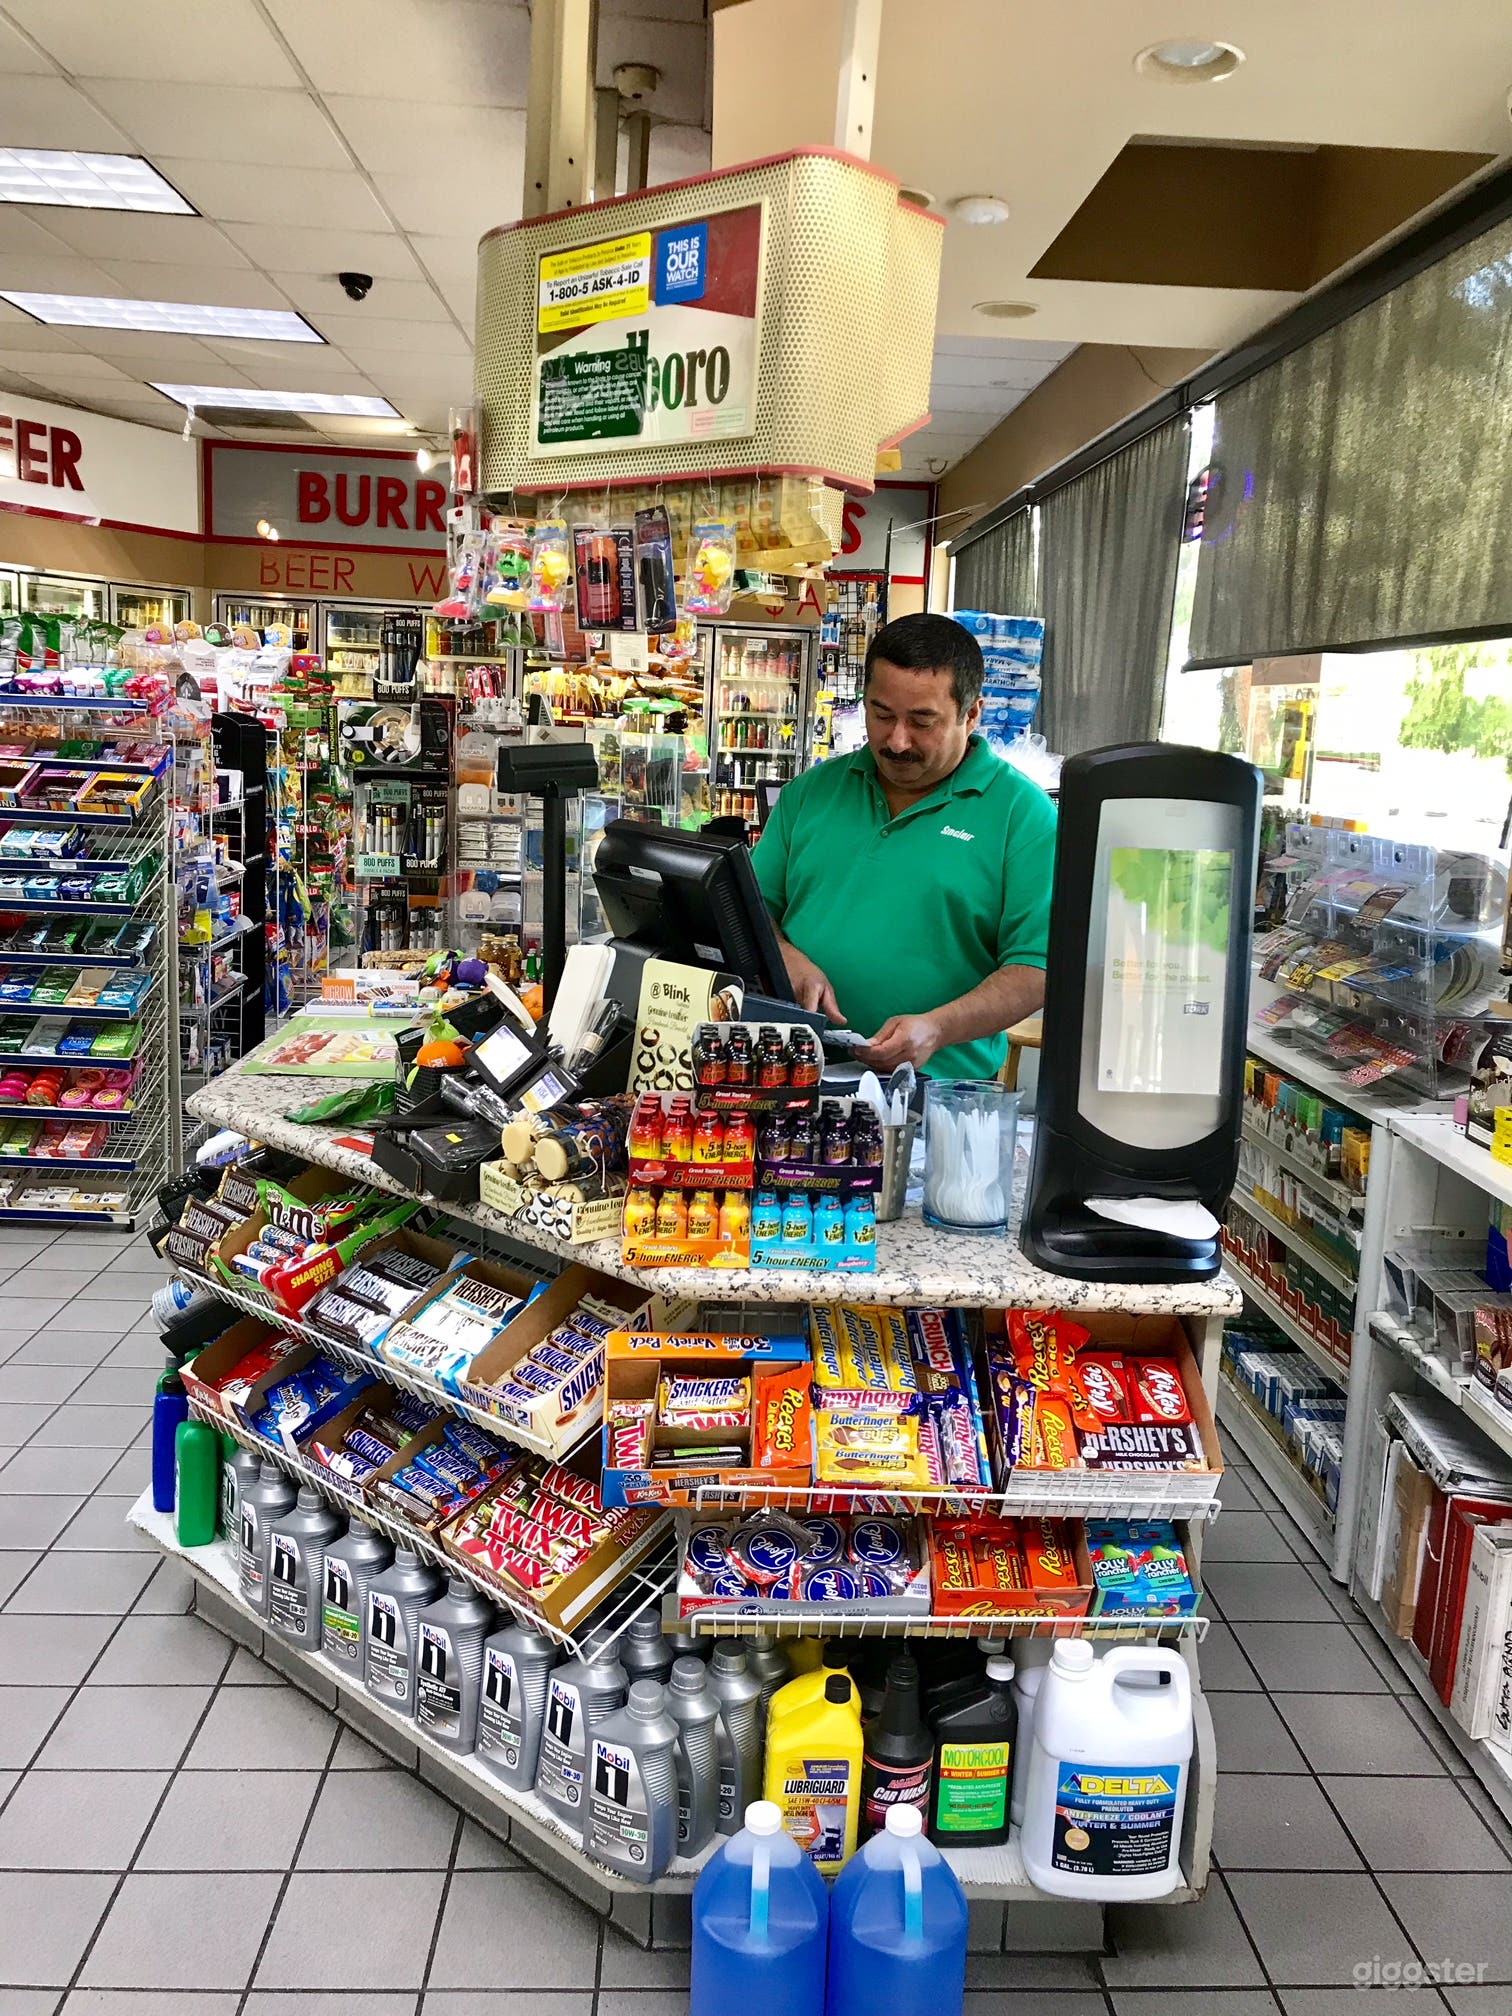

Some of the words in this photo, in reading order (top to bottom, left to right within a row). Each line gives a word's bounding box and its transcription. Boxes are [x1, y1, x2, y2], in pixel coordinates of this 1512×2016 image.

[668, 239, 689, 254] THIS
[690, 236, 700, 249] IS
[667, 250, 699, 271] OUR
[553, 277, 570, 287] Report
[621, 263, 632, 271] Sale
[633, 260, 644, 269] Call
[667, 266, 699, 283] WATCH
[549, 282, 589, 302] 1-800-5
[591, 270, 641, 293] ASK-4-ID
[574, 360, 612, 374] Warning
[259, 552, 356, 593] BEER
[377, 684, 390, 694] 800
[391, 684, 410, 695] PUFFS
[984, 678, 1016, 688] ARATHON
[940, 825, 975, 841] Sinclair
[363, 858, 376, 867] 800
[377, 858, 395, 868] PUFFS
[406, 860, 419, 868] 800
[420, 860, 438, 869] PUFFS
[381, 889, 391, 897] 800
[391, 889, 406, 897] PUFFS
[1112, 970, 1144, 980] Better
[663, 983, 690, 1003] Blink
[1184, 1004, 1209, 1015] TORK
[726, 1140, 747, 1151] 5-hour
[712, 1175, 752, 1185] ENERGY
[795, 1169, 815, 1177] Tasting
[576, 1203, 609, 1214] Genuine
[186, 1207, 225, 1239] HERSHEY'S
[690, 1217, 711, 1227] 5-hour
[758, 1220, 780, 1230] 5-hour
[785, 1220, 808, 1230] 5-hour
[168, 1230, 205, 1261] HERSHEY'S
[377, 1247, 441, 1283] HERSHEY'S
[626, 1248, 664, 1263] 5-hour
[664, 1253, 705, 1264] ENERGY
[752, 1250, 790, 1266] 5-hour
[790, 1258, 830, 1268] ENERGY
[291, 1257, 334, 1289] SHARING
[314, 1268, 336, 1287] SIZE
[453, 1279, 514, 1316] HERSHEY'S
[630, 1336, 661, 1349] Pack
[667, 1336, 717, 1350] Variety
[741, 1337, 772, 1351] 30
[814, 1306, 842, 1380] Butterfinger
[842, 1307, 868, 1385] Butterfinger
[920, 1311, 950, 1371] CRUNCH
[860, 1317, 889, 1390] Butterfinger
[888, 1316, 916, 1394] Butterfinger
[1027, 1319, 1050, 1391] Reese's
[517, 1366, 563, 1391] SNICKE
[561, 1355, 605, 1411] SNICK
[670, 1379, 741, 1398] SNICKERS
[516, 1409, 529, 1422] 2
[777, 1388, 804, 1451] Reese's
[830, 1414, 894, 1426] Butterfinger
[862, 1429, 900, 1442] CUPS
[1042, 1409, 1068, 1469] Reese's
[1085, 1425, 1188, 1452] HERSHEY'S
[349, 1430, 397, 1465] SNICKER
[836, 1451, 902, 1460] Butterfinger
[429, 1450, 478, 1482] SNICKERS
[868, 1461, 908, 1470] CUPS
[405, 1471, 453, 1499] SNICKERS
[542, 1465, 603, 1512] TWIX
[674, 1476, 715, 1488] HERSHEY'S
[530, 1489, 601, 1546] TWIX
[491, 1499, 561, 1560] TWIX
[275, 1536, 296, 1557] Mobil
[703, 1530, 720, 1566] York
[751, 1534, 789, 1567] York
[867, 1521, 882, 1563] York
[1038, 1518, 1063, 1577] Reese's
[281, 1552, 289, 1581] 1
[326, 1557, 348, 1580] Mobil
[484, 1530, 553, 1588] TWIX
[1094, 1557, 1127, 1573] JOLLY
[1143, 1558, 1177, 1574] JOLLY
[1097, 1566, 1131, 1577] rancher
[1147, 1567, 1181, 1579] rancher
[333, 1575, 341, 1605] 1
[371, 1593, 396, 1616] Mobil
[744, 1606, 761, 1615] York
[959, 1600, 1058, 1618] Reese's
[1110, 1606, 1145, 1617] JOLLY
[342, 1630, 358, 1640] 0W-20
[379, 1612, 388, 1642] 1
[423, 1625, 447, 1650] Mobil
[429, 1644, 438, 1677] 1
[489, 1651, 512, 1677] Mobil
[420, 1678, 438, 1691] Synthetic
[439, 1685, 447, 1694] ATF
[494, 1671, 503, 1704] 1
[552, 1681, 576, 1711] Mobil
[555, 1704, 565, 1739] 1
[502, 1731, 520, 1745] 10W-30
[597, 1743, 630, 1771] Mobil
[943, 1748, 1006, 1767] MOTORCOOL
[563, 1768, 582, 1781] 5W-30
[604, 1764, 617, 1800] 1
[976, 1769, 1001, 1777] SUMMER
[784, 1779, 846, 1795] LUBRIGUARD
[873, 1786, 896, 1803] CAR
[896, 1781, 929, 1802] WASH
[1079, 1774, 1173, 1796] DELTA
[594, 1802, 606, 1812] Keeps
[607, 1807, 616, 1815] Your
[617, 1810, 633, 1820] Engine
[594, 1808, 610, 1820] Running
[611, 1815, 620, 1823] Like
[621, 1818, 632, 1826] New
[1063, 1809, 1120, 1822] ANTI-FREEZE
[1128, 1811, 1167, 1821] COOLANT
[621, 1828, 647, 1841] 10W-30
[1070, 1820, 1107, 1829] WINTER
[1120, 1821, 1161, 1830] SUMMER
